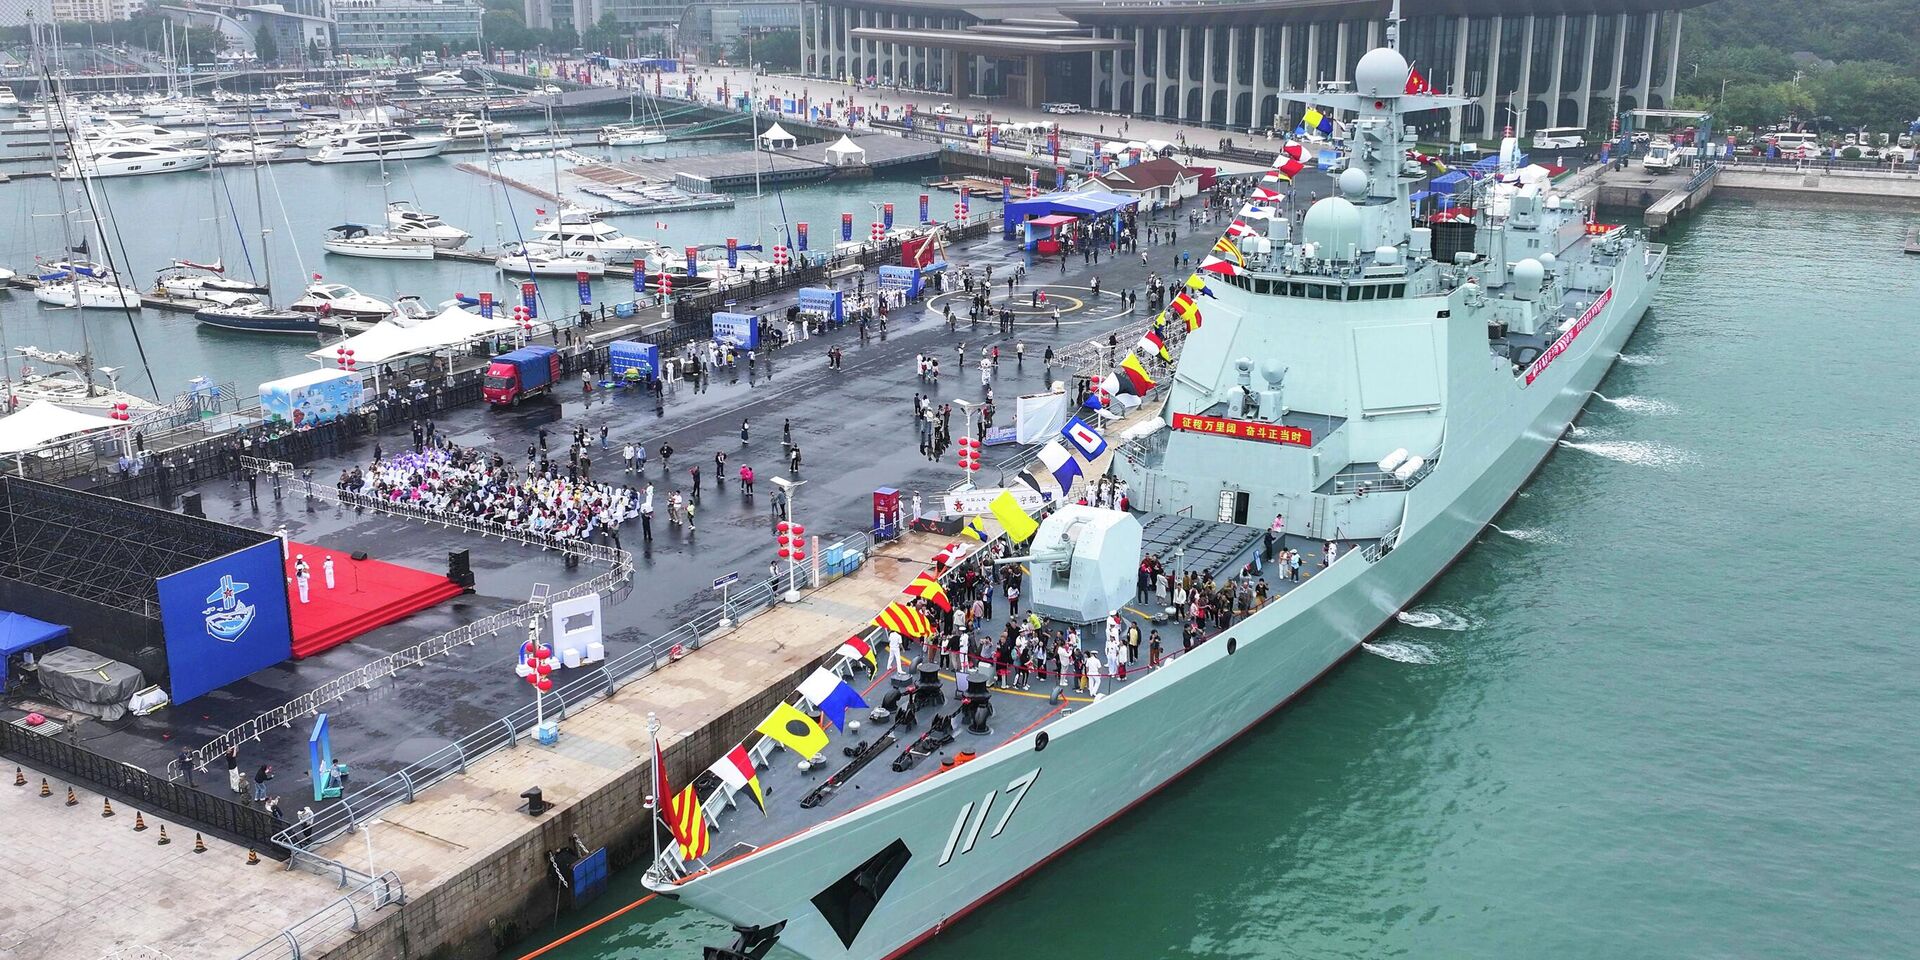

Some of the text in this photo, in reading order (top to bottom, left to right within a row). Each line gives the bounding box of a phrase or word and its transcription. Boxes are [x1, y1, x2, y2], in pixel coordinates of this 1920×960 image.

[1182, 416, 1302, 443] 征程万里阔 奋斗正当时
[938, 767, 1042, 867] 117
